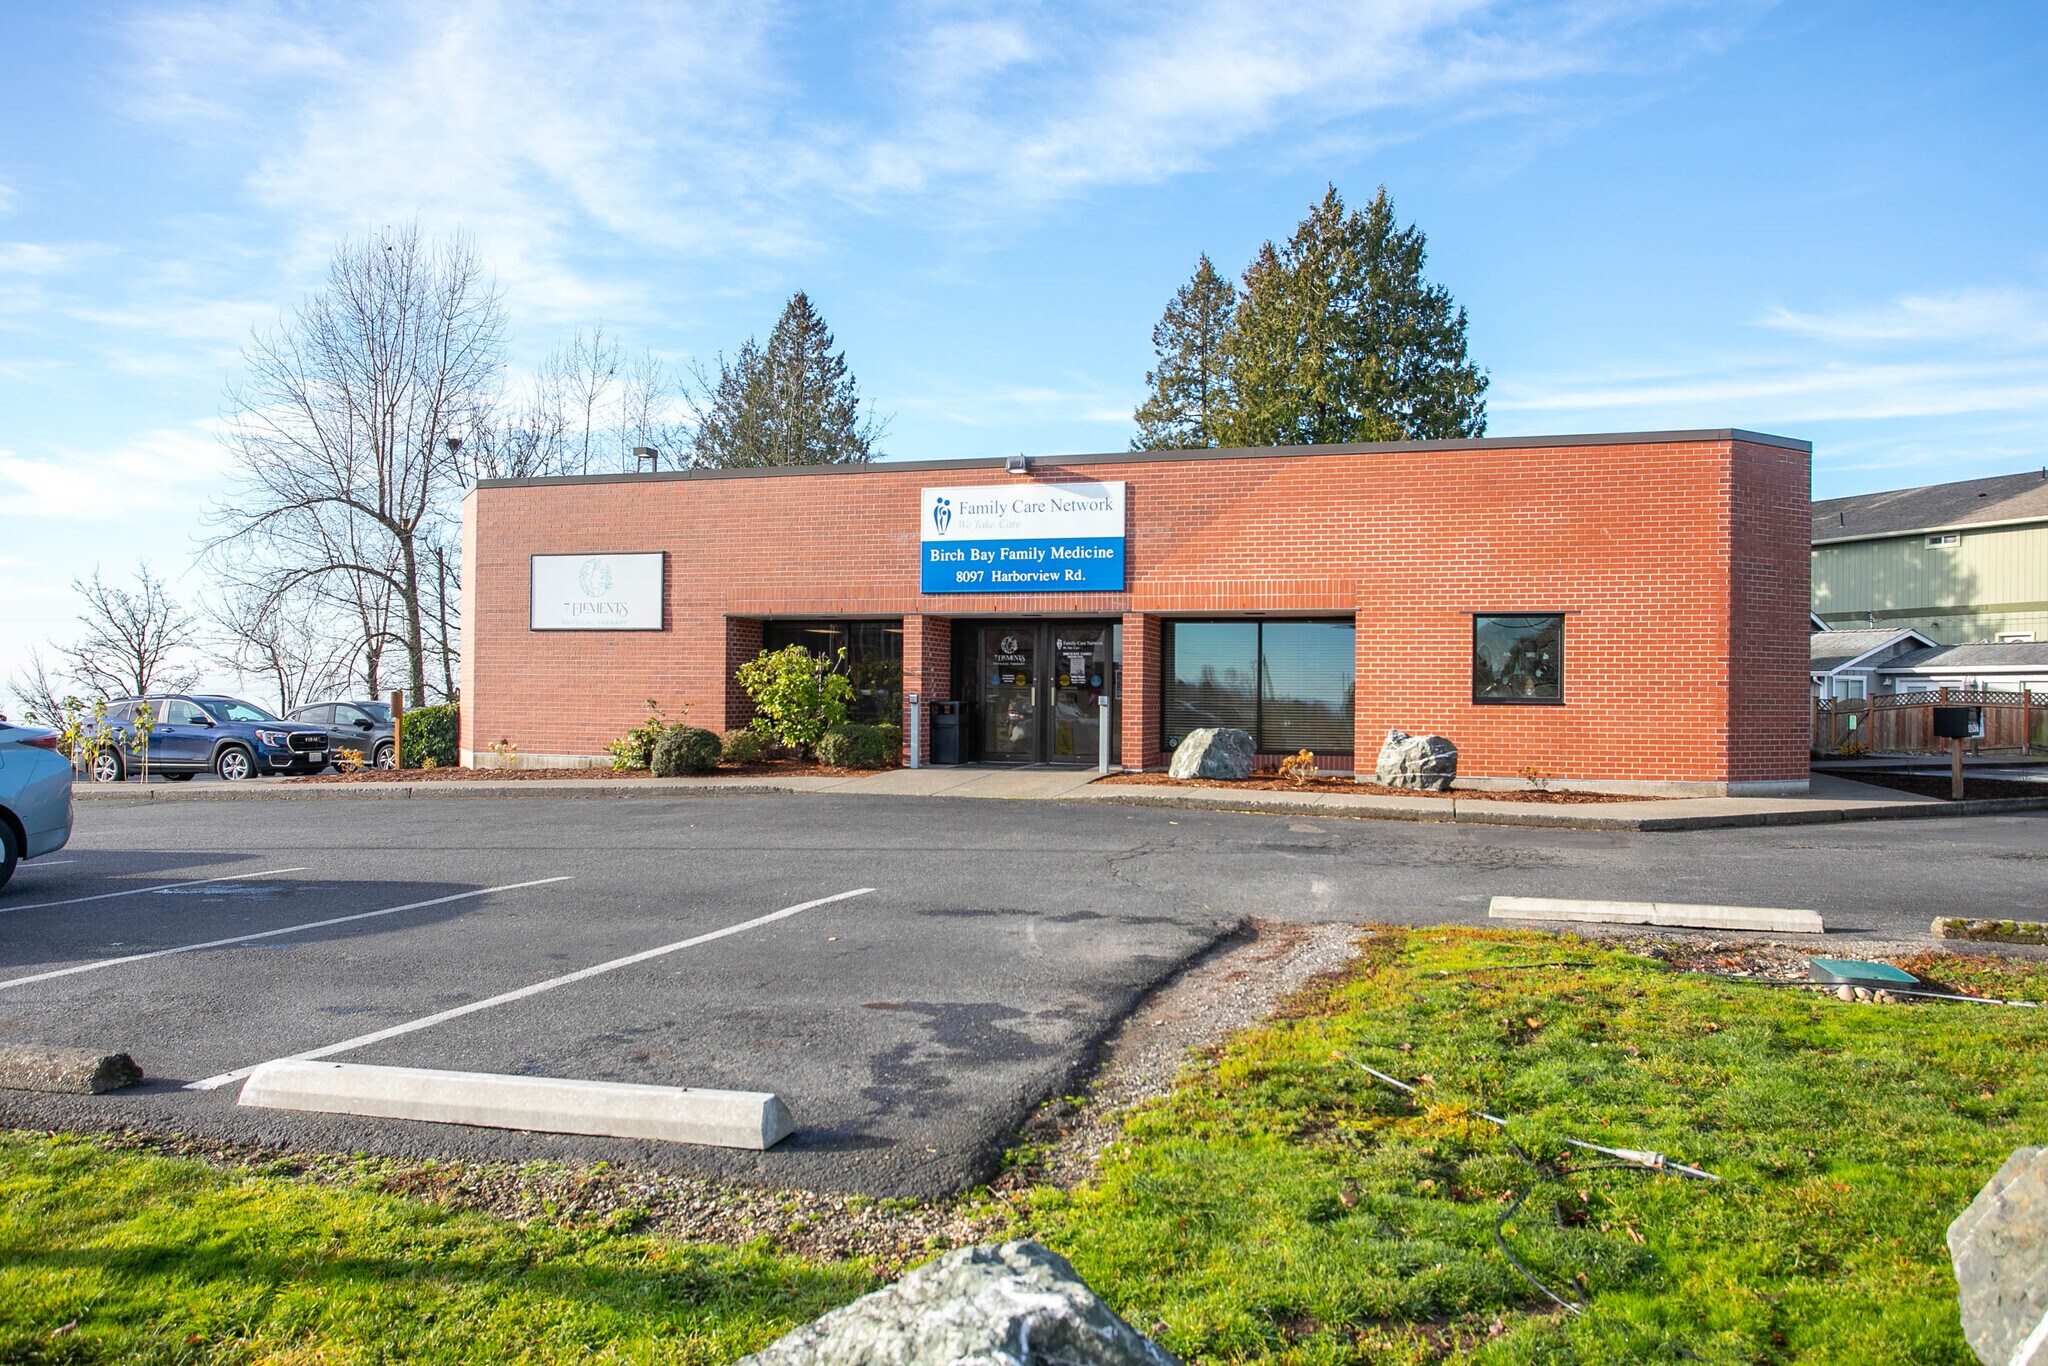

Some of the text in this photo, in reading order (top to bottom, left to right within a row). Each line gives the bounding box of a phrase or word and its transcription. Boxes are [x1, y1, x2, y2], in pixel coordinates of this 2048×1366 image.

[959, 497, 1114, 517] Family Care Network
[959, 519, 1022, 529] We Take Care
[930, 545, 1114, 564] Birch Bay Family Medicine
[955, 569, 1086, 583] 8097 Harborview Rd.
[572, 602, 629, 617] ELEMENTS
